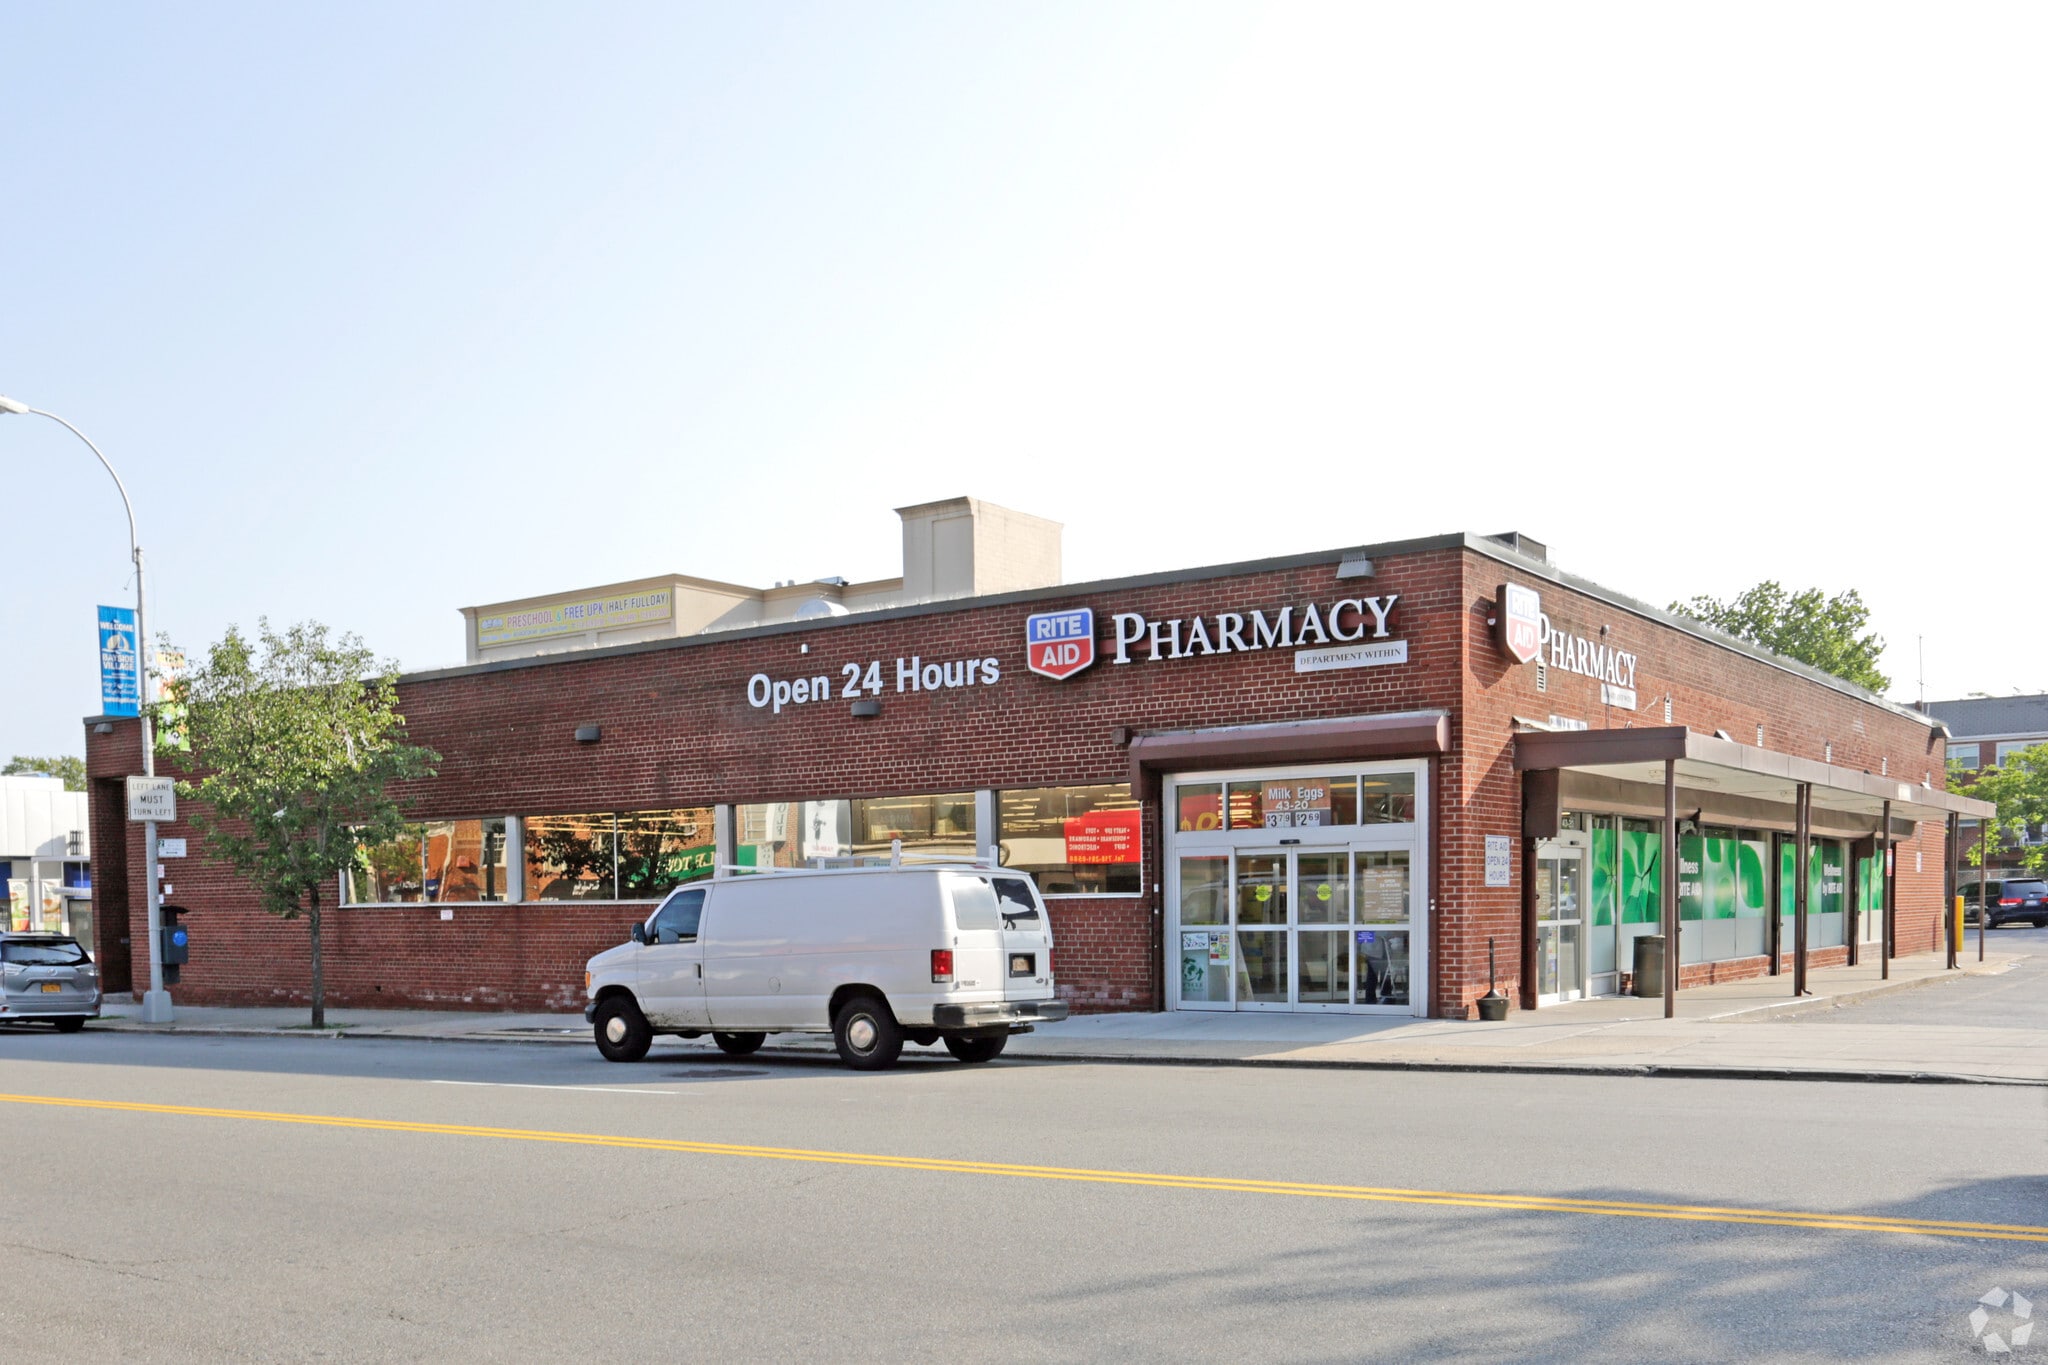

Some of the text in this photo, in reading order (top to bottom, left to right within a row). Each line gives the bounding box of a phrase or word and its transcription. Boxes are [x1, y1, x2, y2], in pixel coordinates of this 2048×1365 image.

[1512, 591, 1536, 617] RITE
[507, 610, 553, 629] PRESCHOOL
[564, 604, 584, 620] FREE
[587, 602, 603, 617] UPK
[100, 621, 134, 632] WELCOME
[1036, 614, 1082, 639] RITE
[1112, 595, 1398, 665] PHARMACY
[1514, 624, 1534, 649] AID
[103, 653, 135, 664] BAYSIDE
[1041, 643, 1080, 667] AID
[1300, 648, 1401, 665] DEPARTMENT WITHIN
[1535, 613, 1637, 688] PHARMACY
[103, 661, 135, 671] VILLAGE
[748, 656, 1000, 714] Open 24 Hours
[132, 783, 170, 791] LEFT LANE
[1268, 787, 1324, 800] Milk Eggs
[140, 795, 163, 804] MUST
[1275, 800, 1309, 810] 43-20
[134, 808, 172, 816] TURN LEFT
